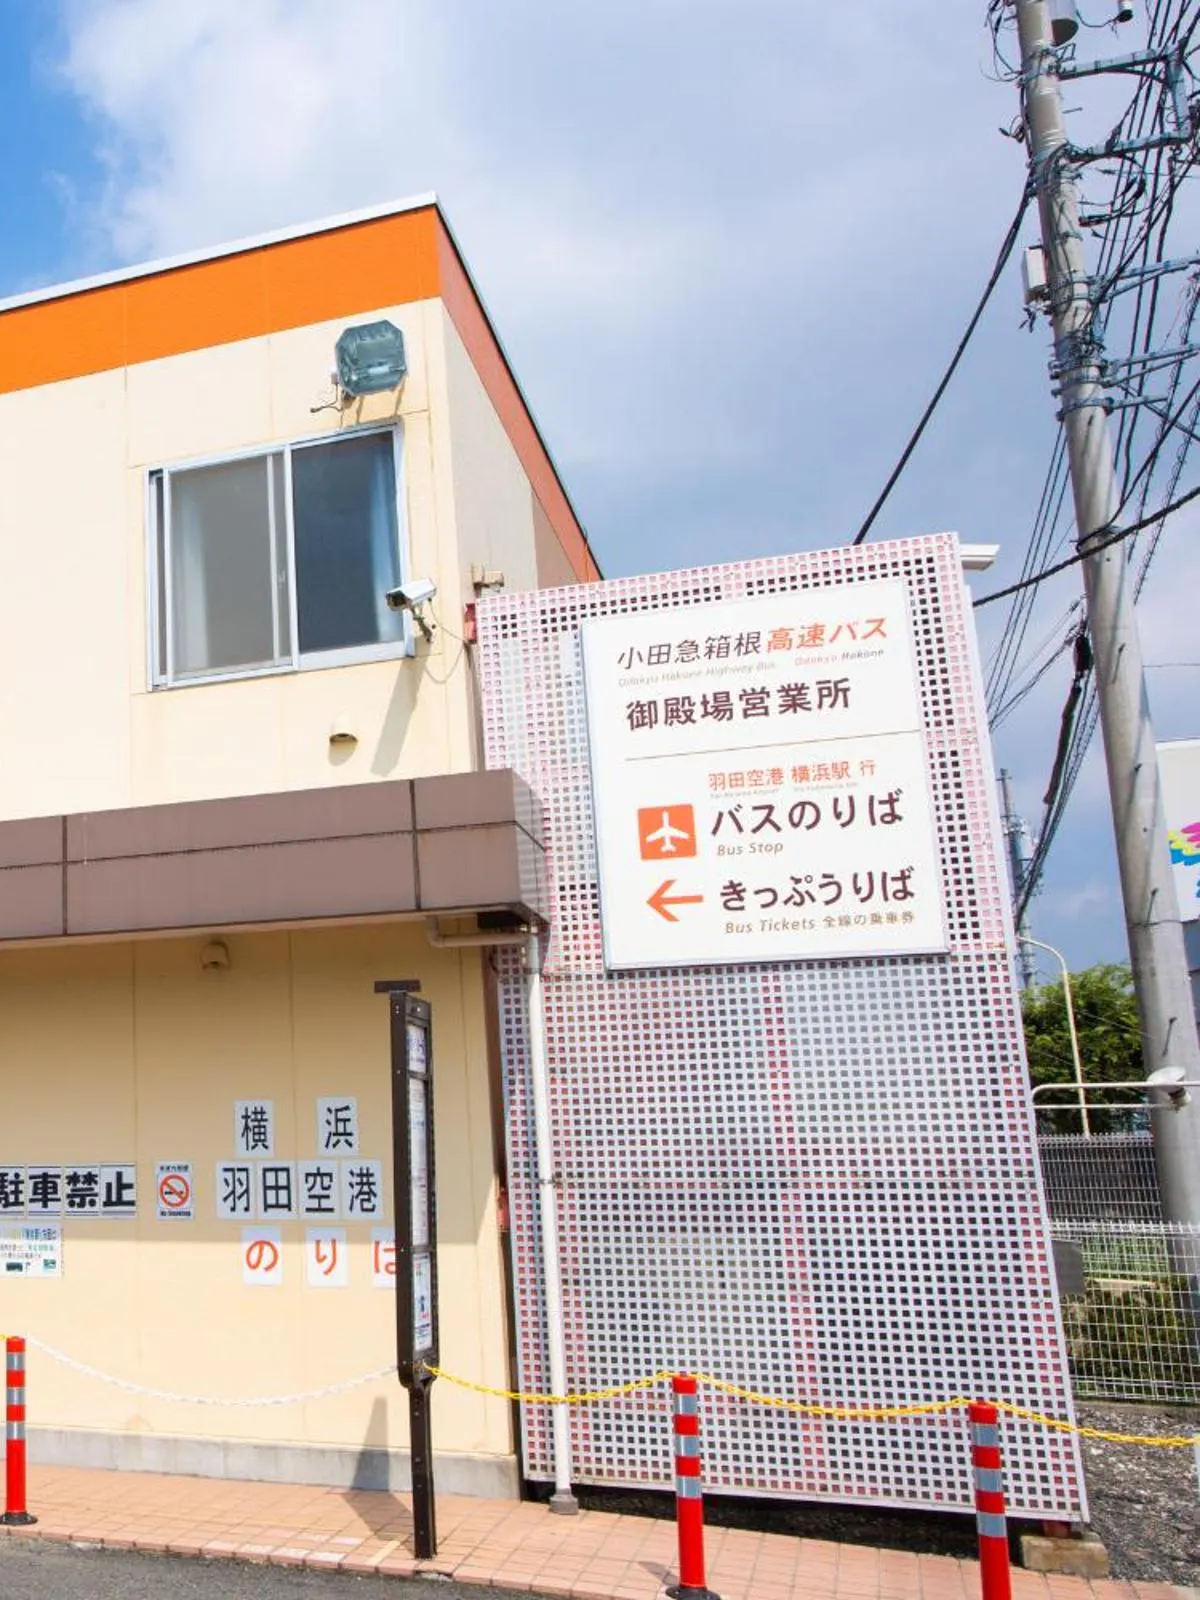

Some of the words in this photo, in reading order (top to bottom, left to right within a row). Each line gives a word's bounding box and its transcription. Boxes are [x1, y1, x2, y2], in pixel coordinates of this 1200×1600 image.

[617, 617, 888, 670] 小田急箱根高速バス
[626, 677, 851, 731] 御殿場営業所
[708, 767, 784, 791] 羽田空港
[791, 761, 851, 784] 横浜駅
[859, 759, 877, 777] 行
[711, 787, 904, 836] バスのりば
[717, 843, 743, 856] Bus
[749, 841, 784, 855] Stop
[720, 865, 915, 911] きっぷうりば
[725, 921, 752, 934] Bus
[759, 917, 815, 932] Tickets
[222, 1166, 378, 1214] 羽田空港
